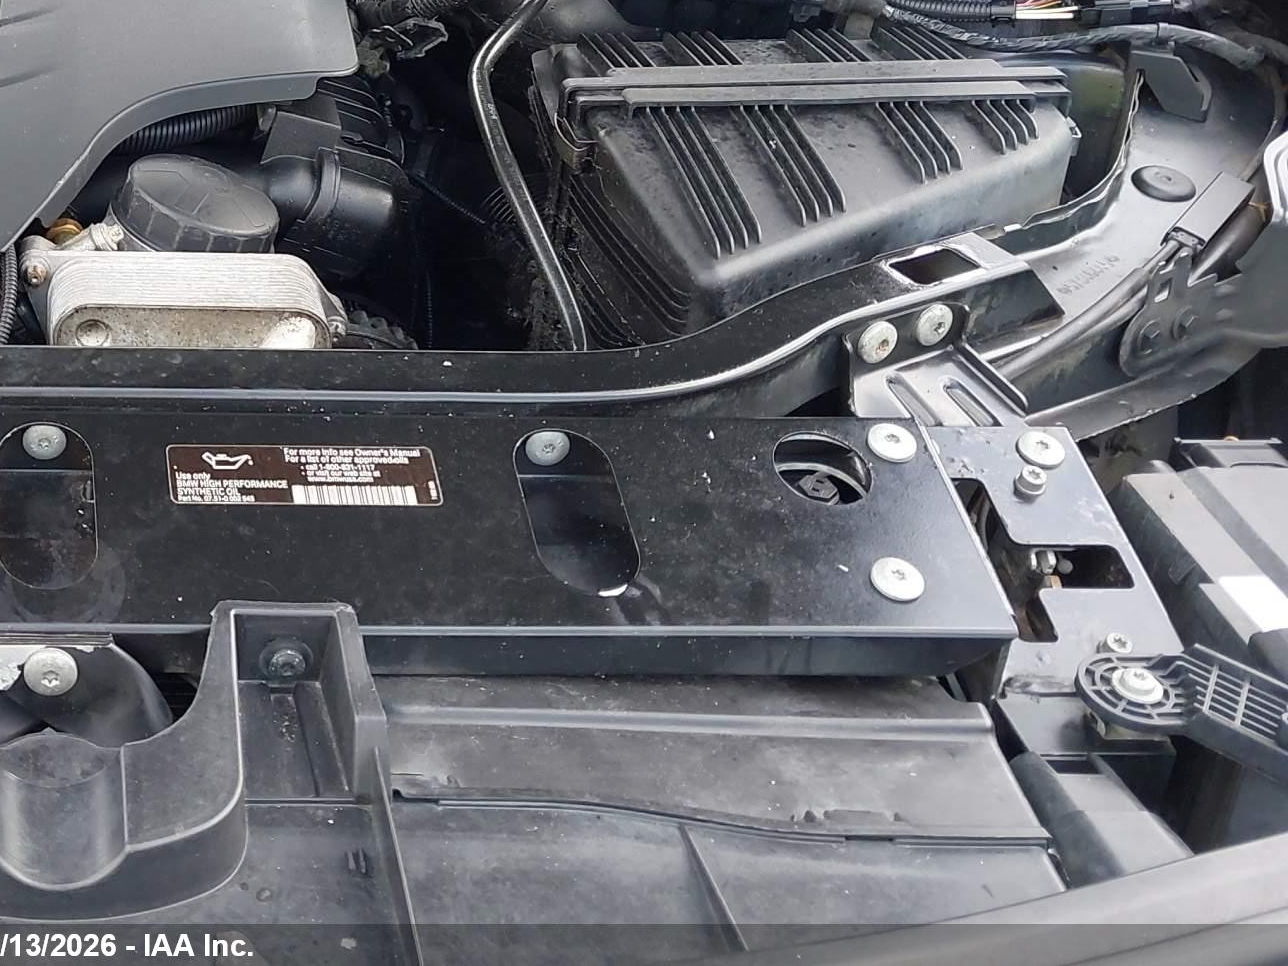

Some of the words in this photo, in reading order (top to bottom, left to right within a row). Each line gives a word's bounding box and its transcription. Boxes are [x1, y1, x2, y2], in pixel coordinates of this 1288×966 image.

[389, 449, 421, 457] Manual
[175, 471, 191, 479] Use
[192, 471, 210, 481] only
[199, 480, 221, 488] HIGH
[222, 480, 289, 489] PERFORMANCE
[225, 488, 241, 496] OIL
